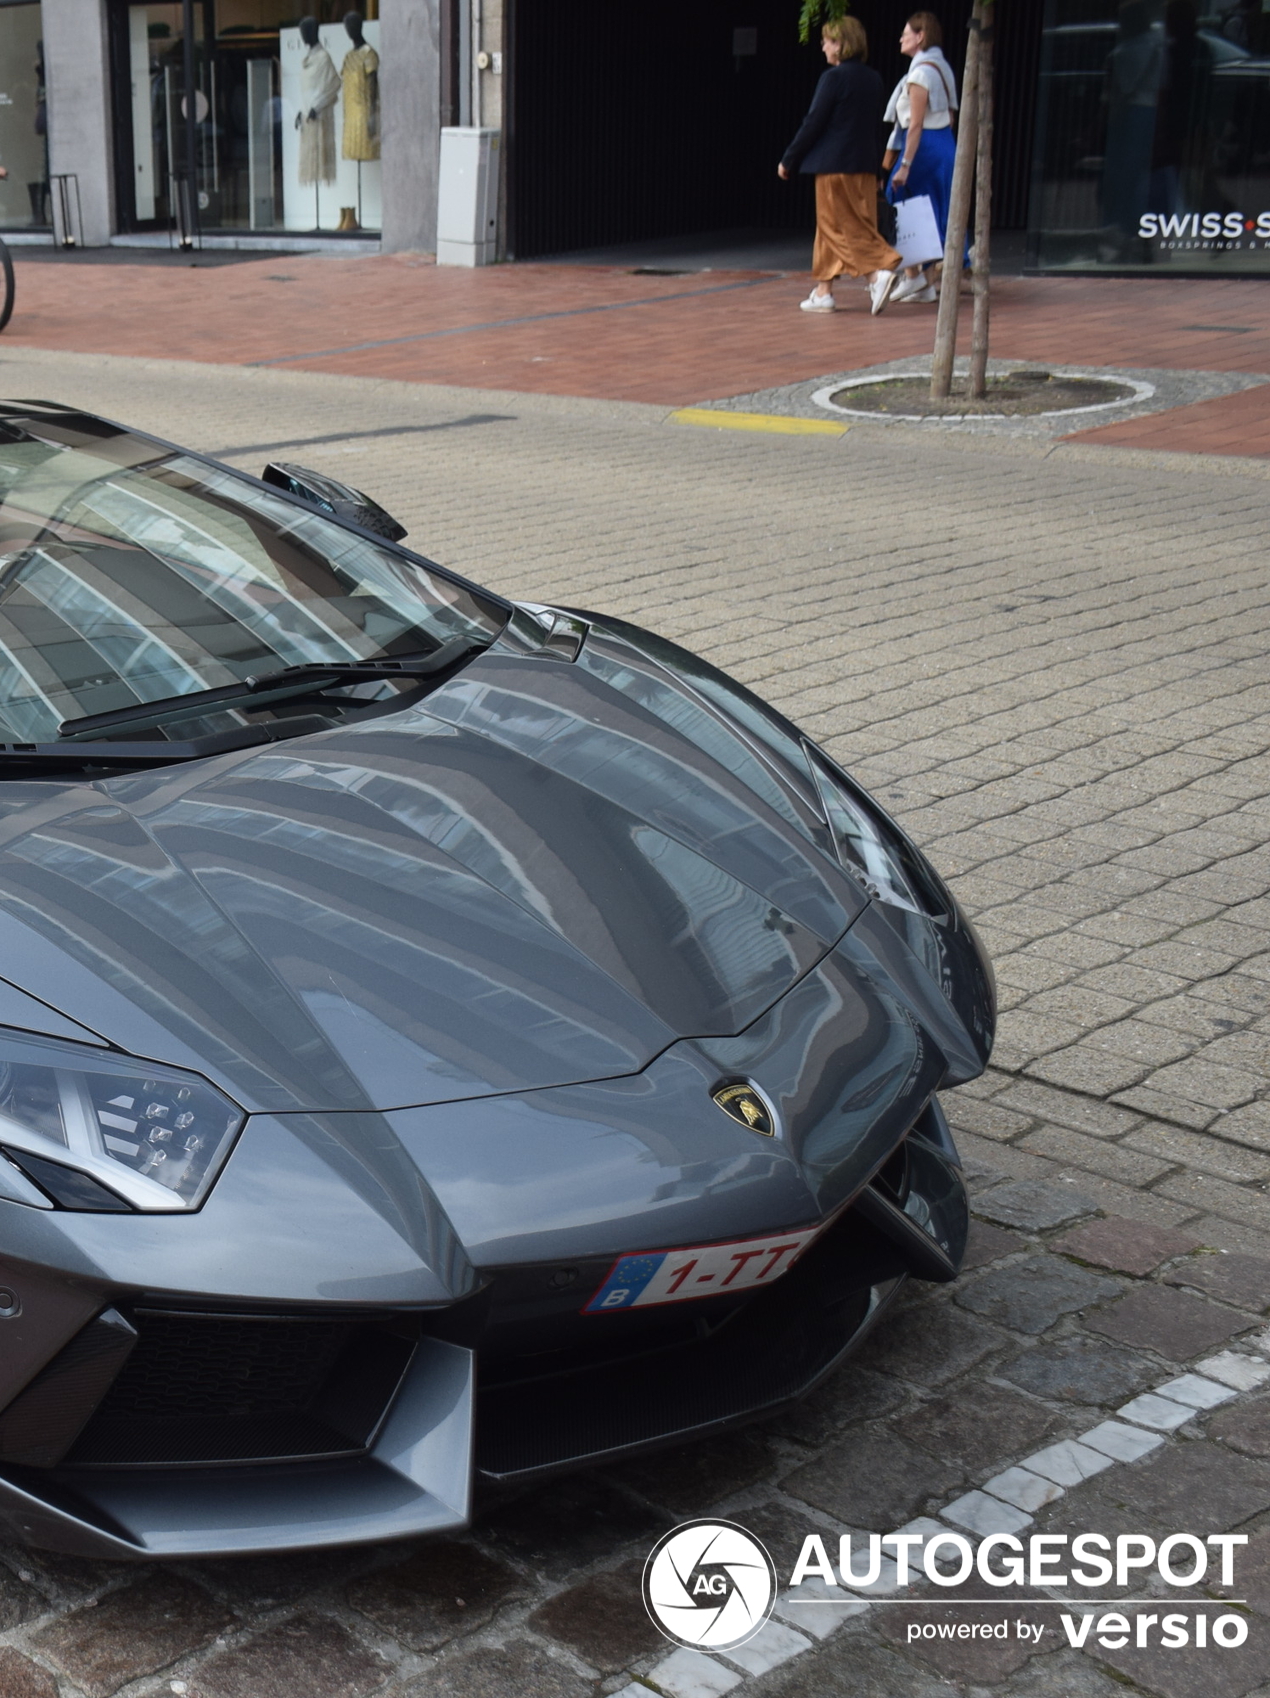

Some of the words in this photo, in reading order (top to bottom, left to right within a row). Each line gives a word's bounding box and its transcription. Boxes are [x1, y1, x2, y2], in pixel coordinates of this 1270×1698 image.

[1138, 212, 1244, 238] SWISS
[1159, 241, 1242, 249] BOXSPRINGS
[666, 1241, 802, 1294] 1-TT
[600, 1289, 630, 1307] B
